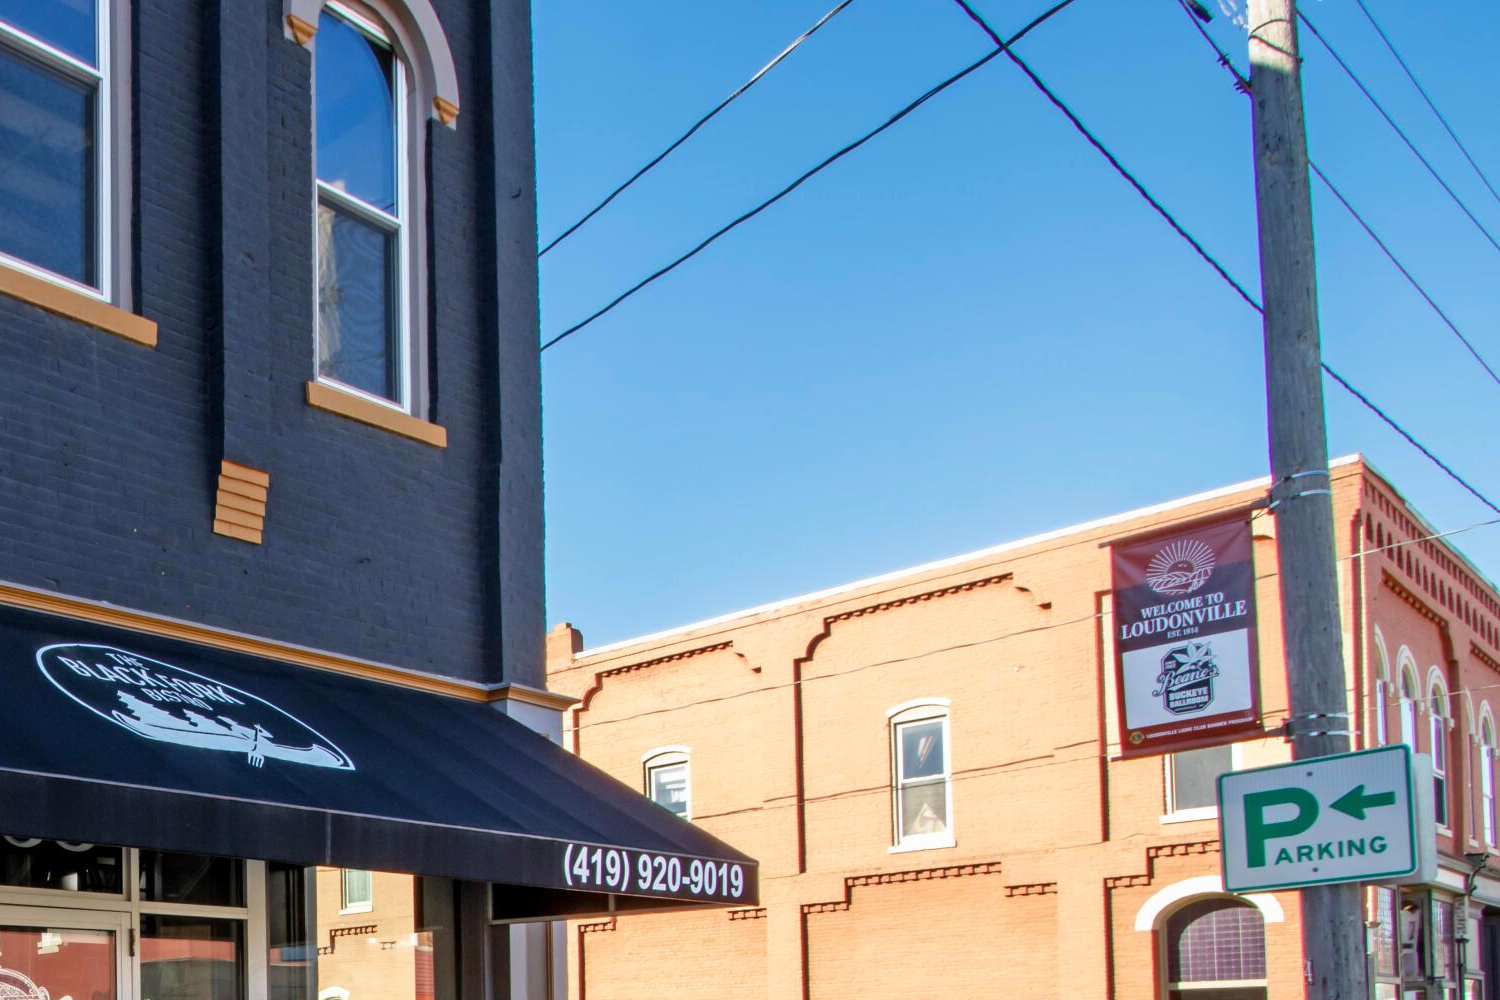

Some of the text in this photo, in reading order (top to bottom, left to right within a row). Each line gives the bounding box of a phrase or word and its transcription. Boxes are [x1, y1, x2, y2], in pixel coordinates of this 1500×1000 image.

[1122, 600, 1247, 639] LOUDONVILLE
[1141, 592, 1224, 619] WELCOME TO
[105, 652, 150, 671] THE
[57, 656, 245, 705] BLACK FORK
[1169, 686, 1208, 701] BUCKEYE
[564, 844, 743, 897] (419) 920-9019
